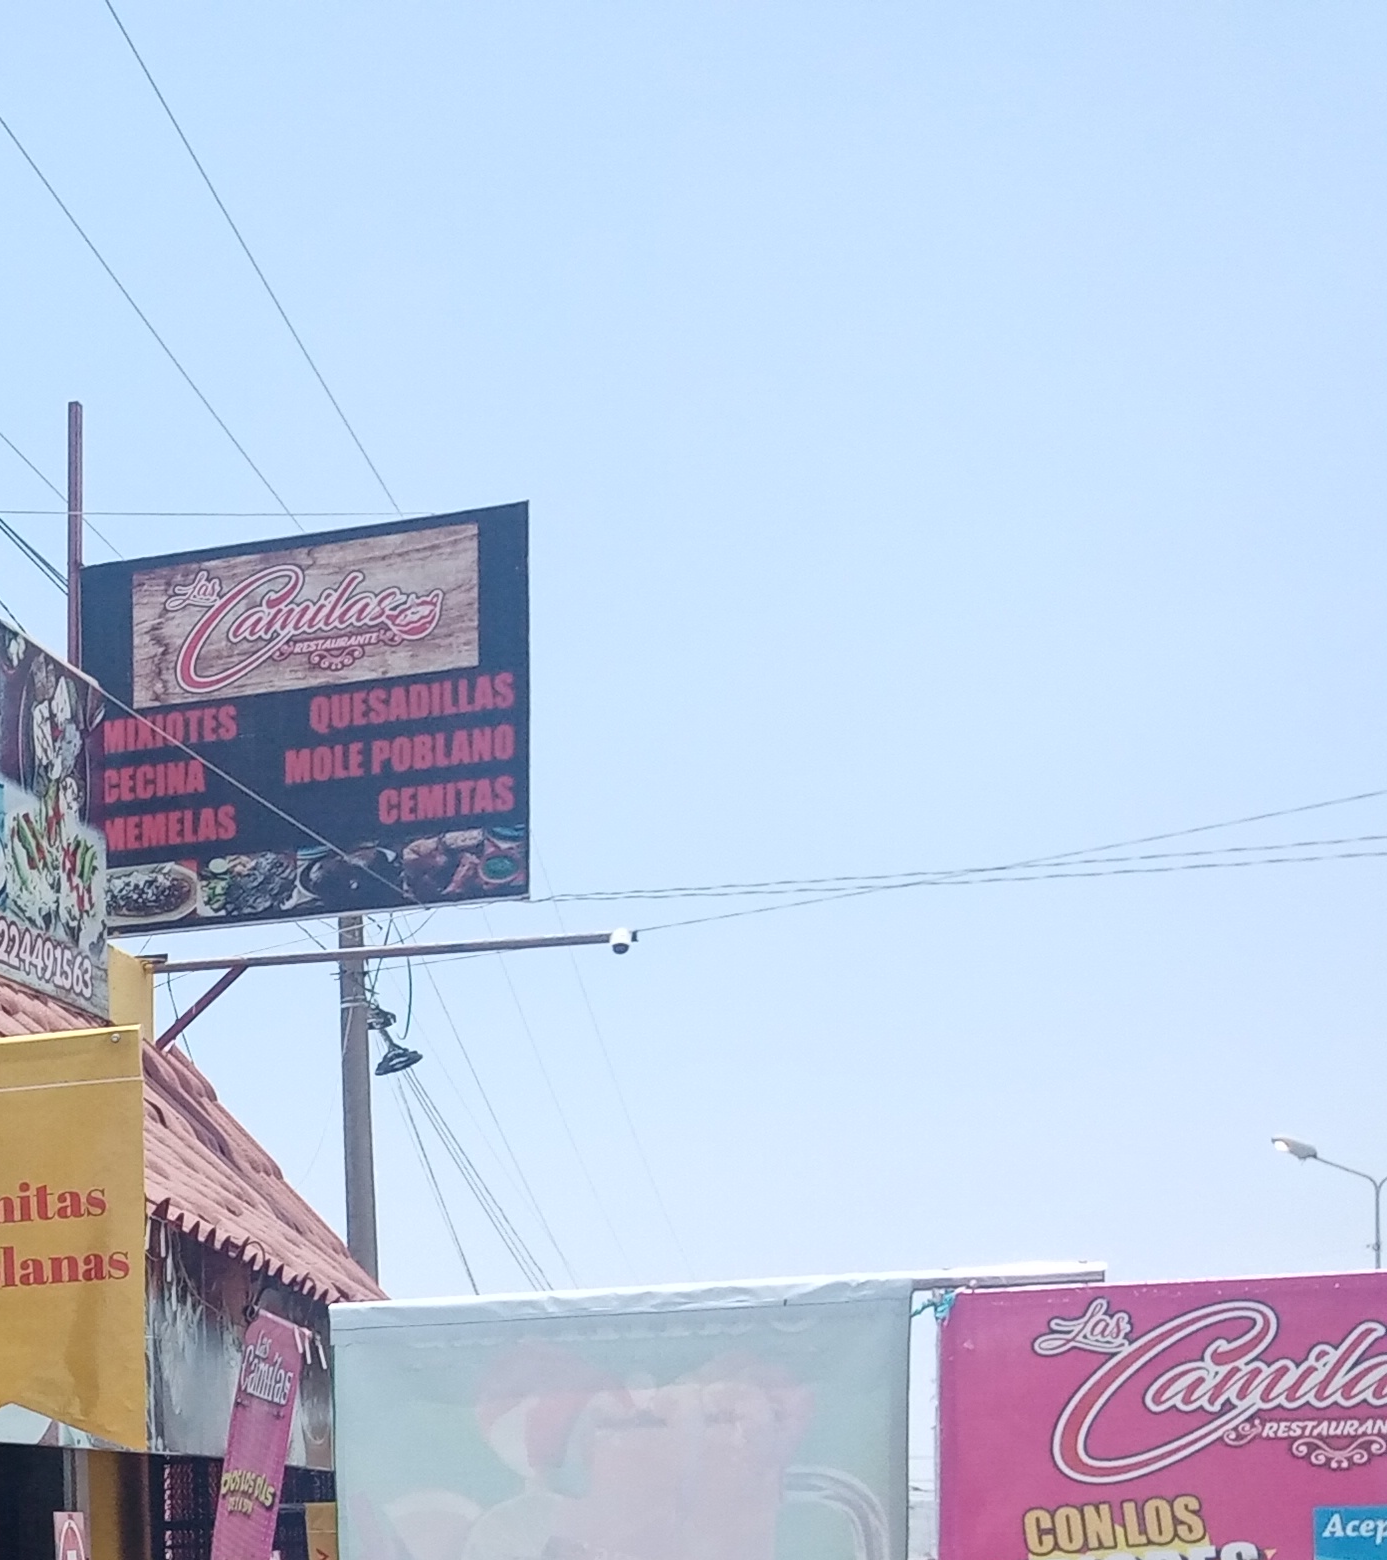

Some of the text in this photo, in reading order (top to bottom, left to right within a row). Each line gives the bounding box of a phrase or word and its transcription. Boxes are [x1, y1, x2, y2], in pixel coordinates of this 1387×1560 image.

[164, 570, 224, 612] Las
[175, 564, 397, 694] Camilas
[293, 632, 380, 656] RESTAURANTE
[103, 704, 239, 754] MIXIOTES
[309, 672, 515, 734] QUESADILLAS
[104, 758, 207, 804] CECINA
[284, 724, 515, 786] MOLE POBLANO
[378, 776, 515, 826] CEMITAS
[1034, 1299, 1131, 1354] Las
[1024, 1495, 1205, 1554] CON LOS
